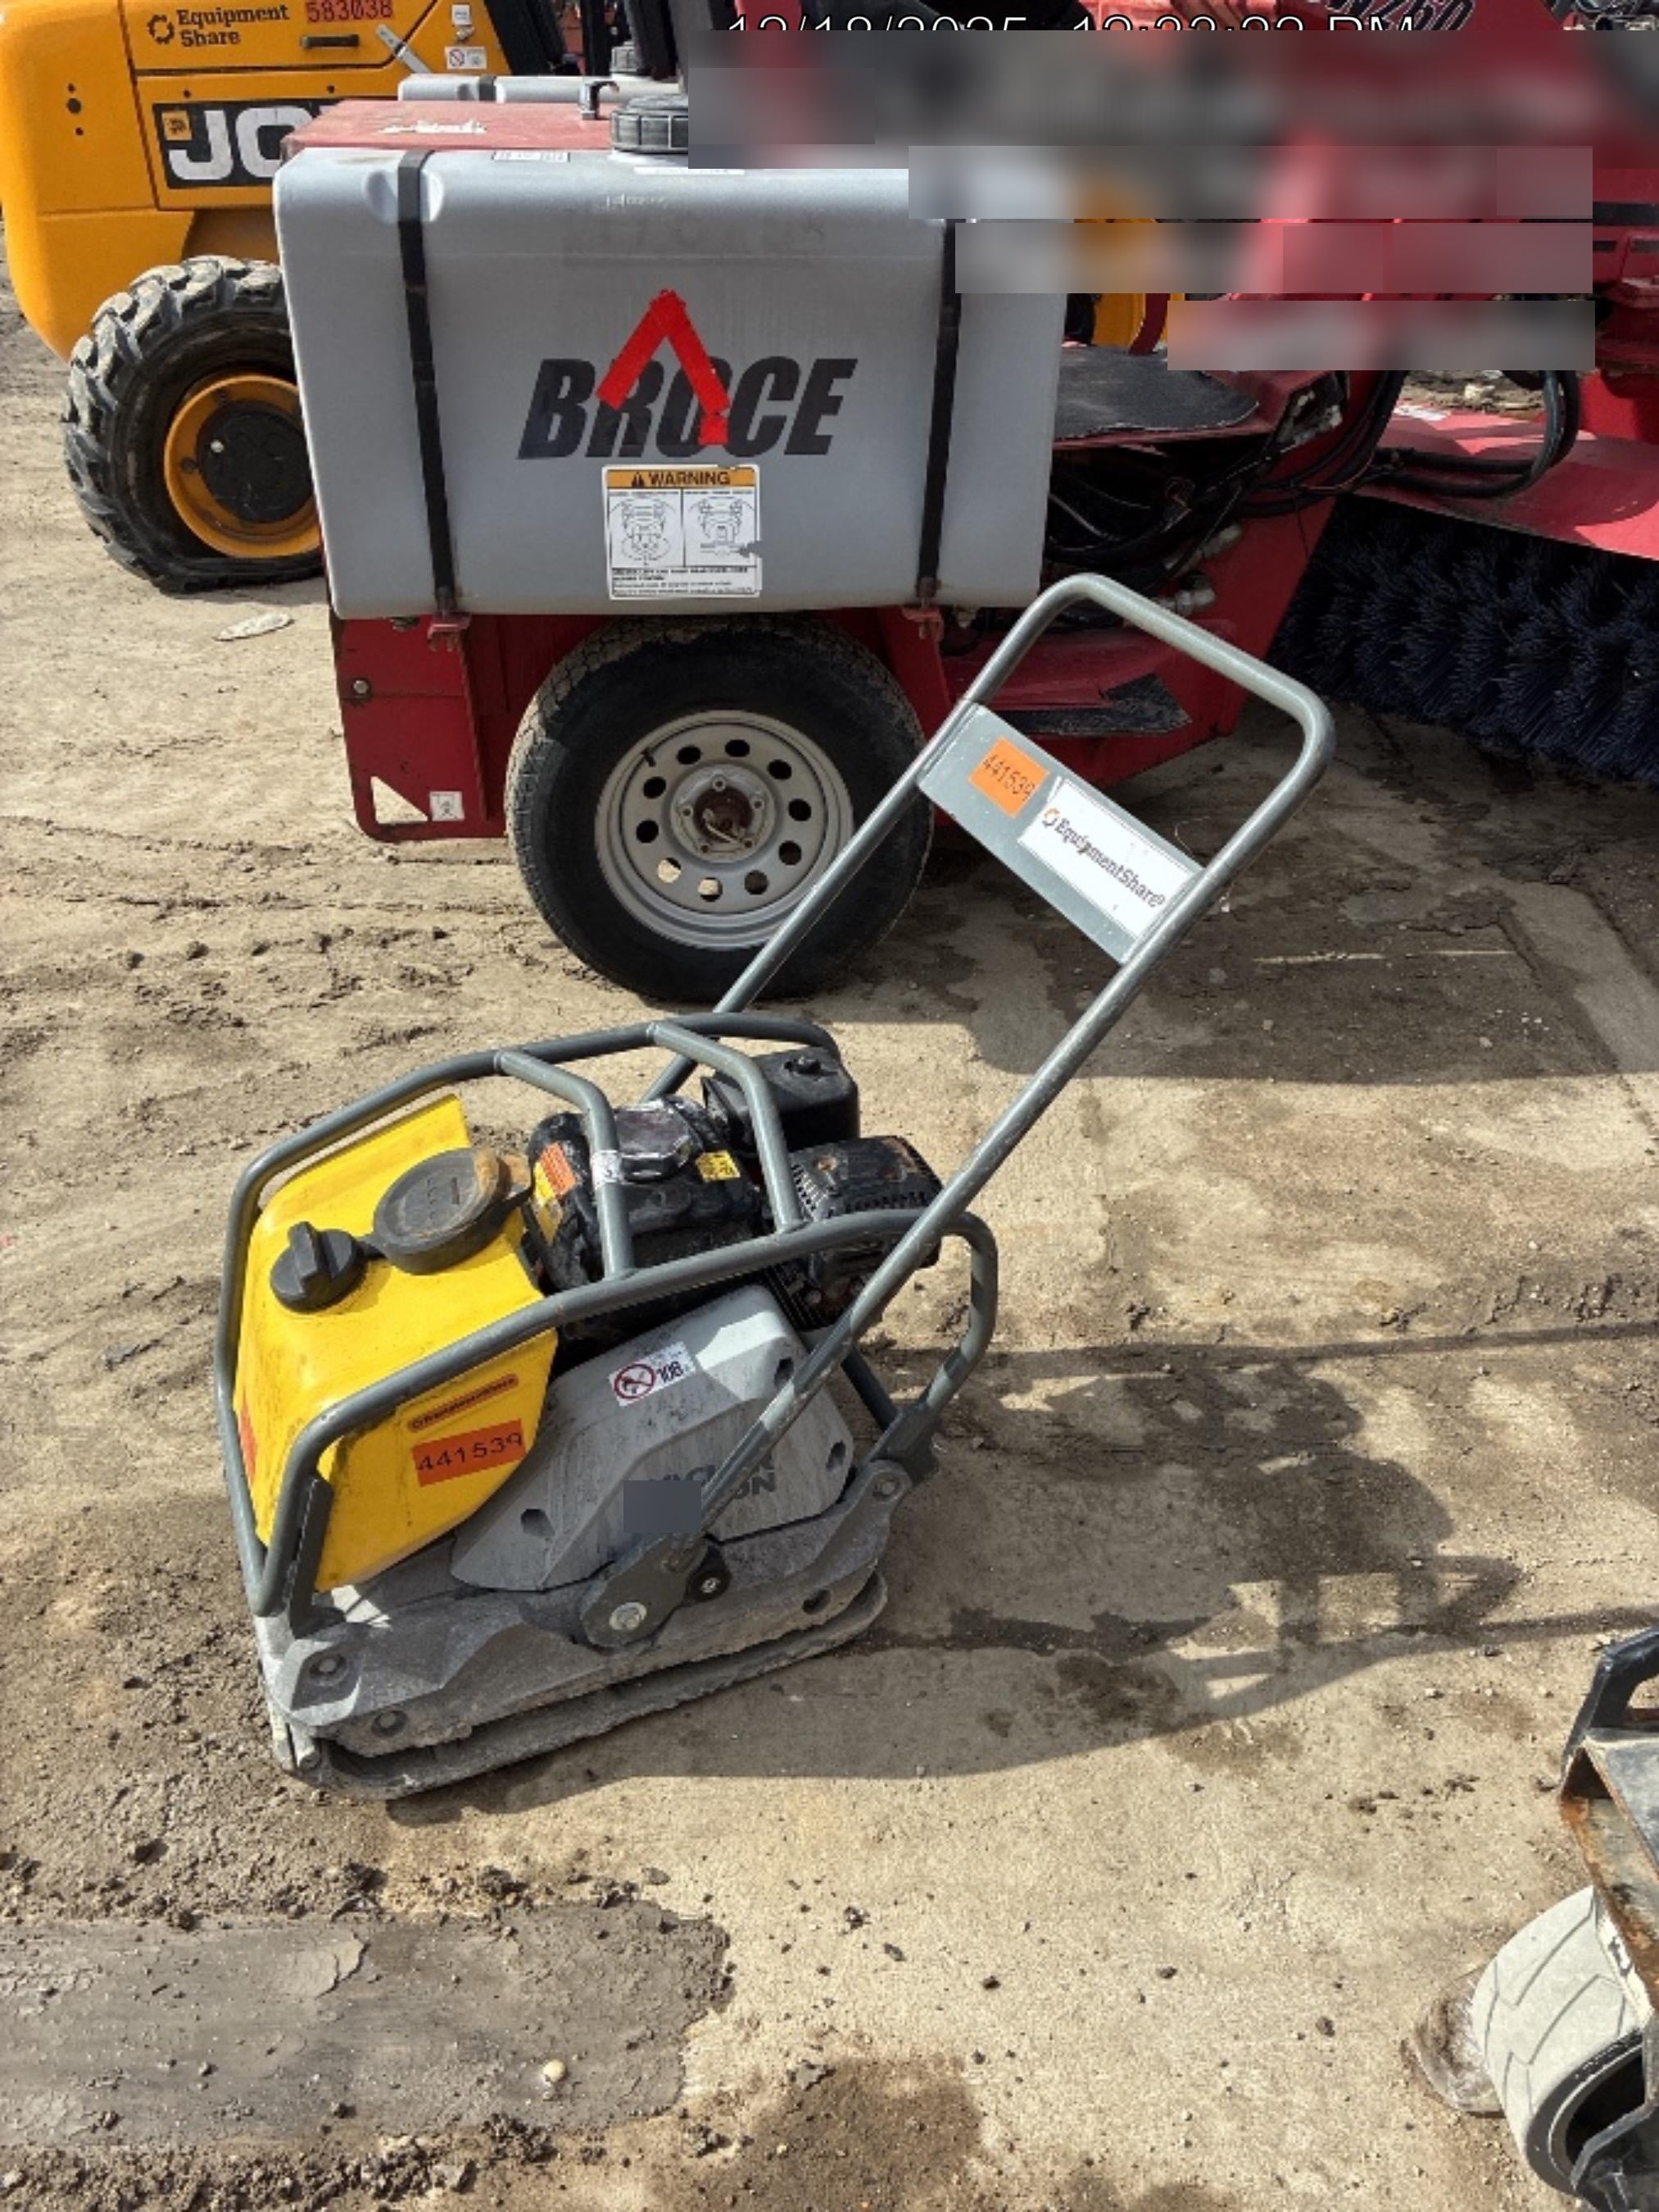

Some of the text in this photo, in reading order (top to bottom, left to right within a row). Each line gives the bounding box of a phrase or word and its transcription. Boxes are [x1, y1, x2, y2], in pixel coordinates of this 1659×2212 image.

[176, 5, 289, 28] Equipment
[179, 29, 241, 48] Share
[168, 105, 329, 180] JC
[517, 356, 859, 460] BROCE
[648, 471, 731, 487] WARNING
[418, 1432, 523, 1471] 441539
